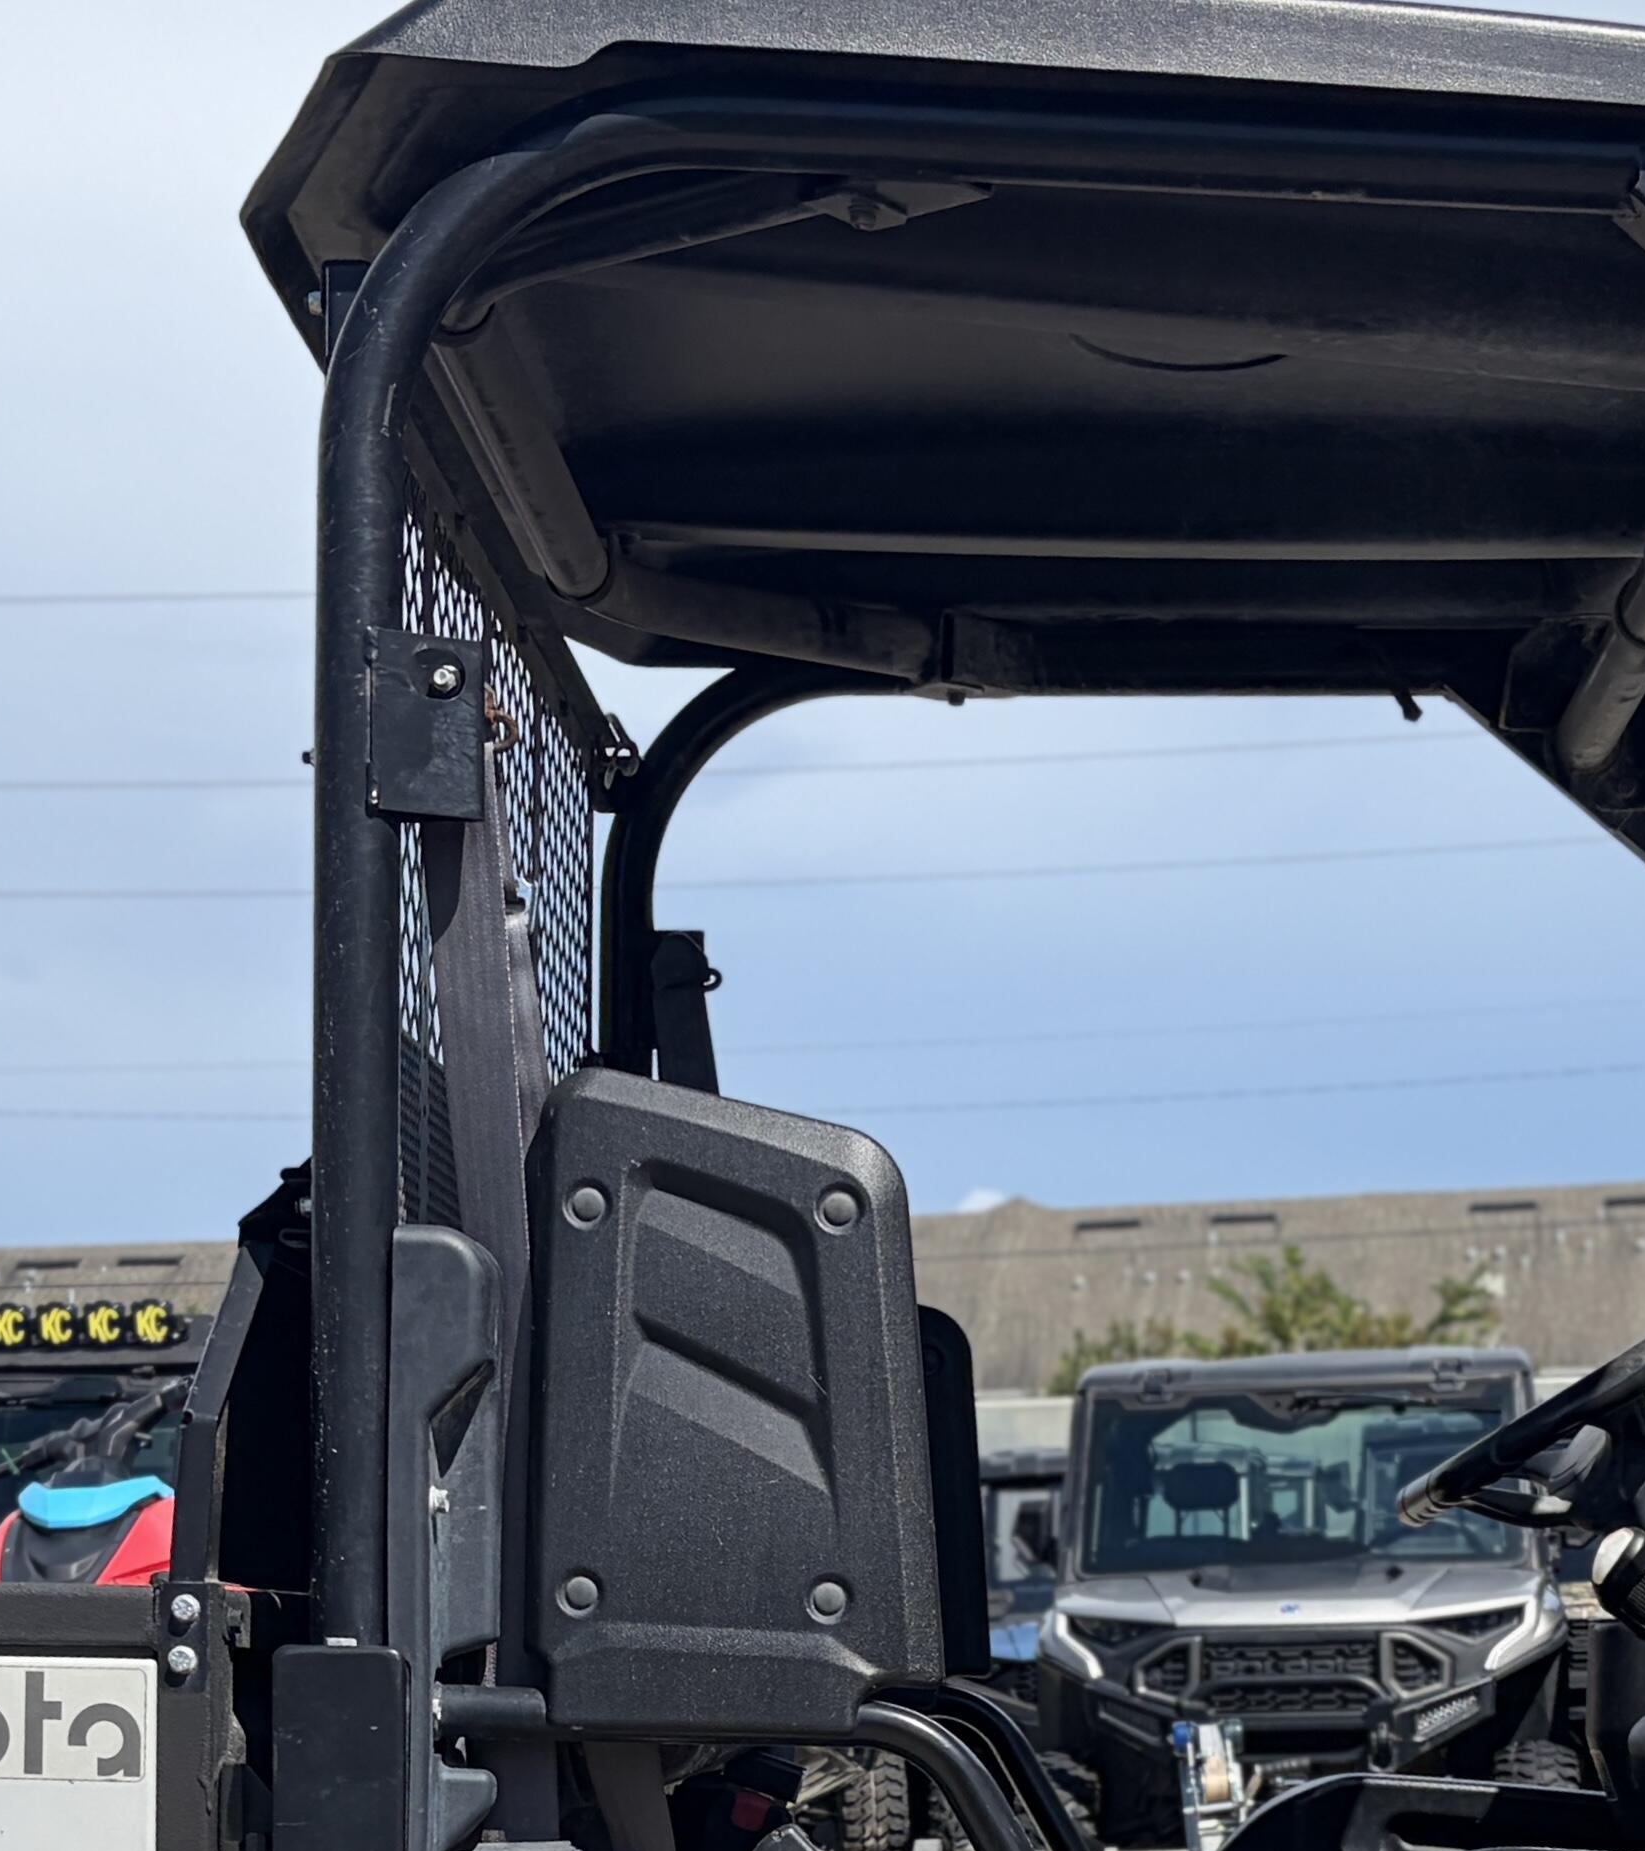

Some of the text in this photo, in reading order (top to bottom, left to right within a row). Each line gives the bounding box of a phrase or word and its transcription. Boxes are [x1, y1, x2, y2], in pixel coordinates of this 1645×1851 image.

[41, 1308, 72, 1344] KC
[88, 1307, 120, 1343] KC
[136, 1305, 168, 1343] KC
